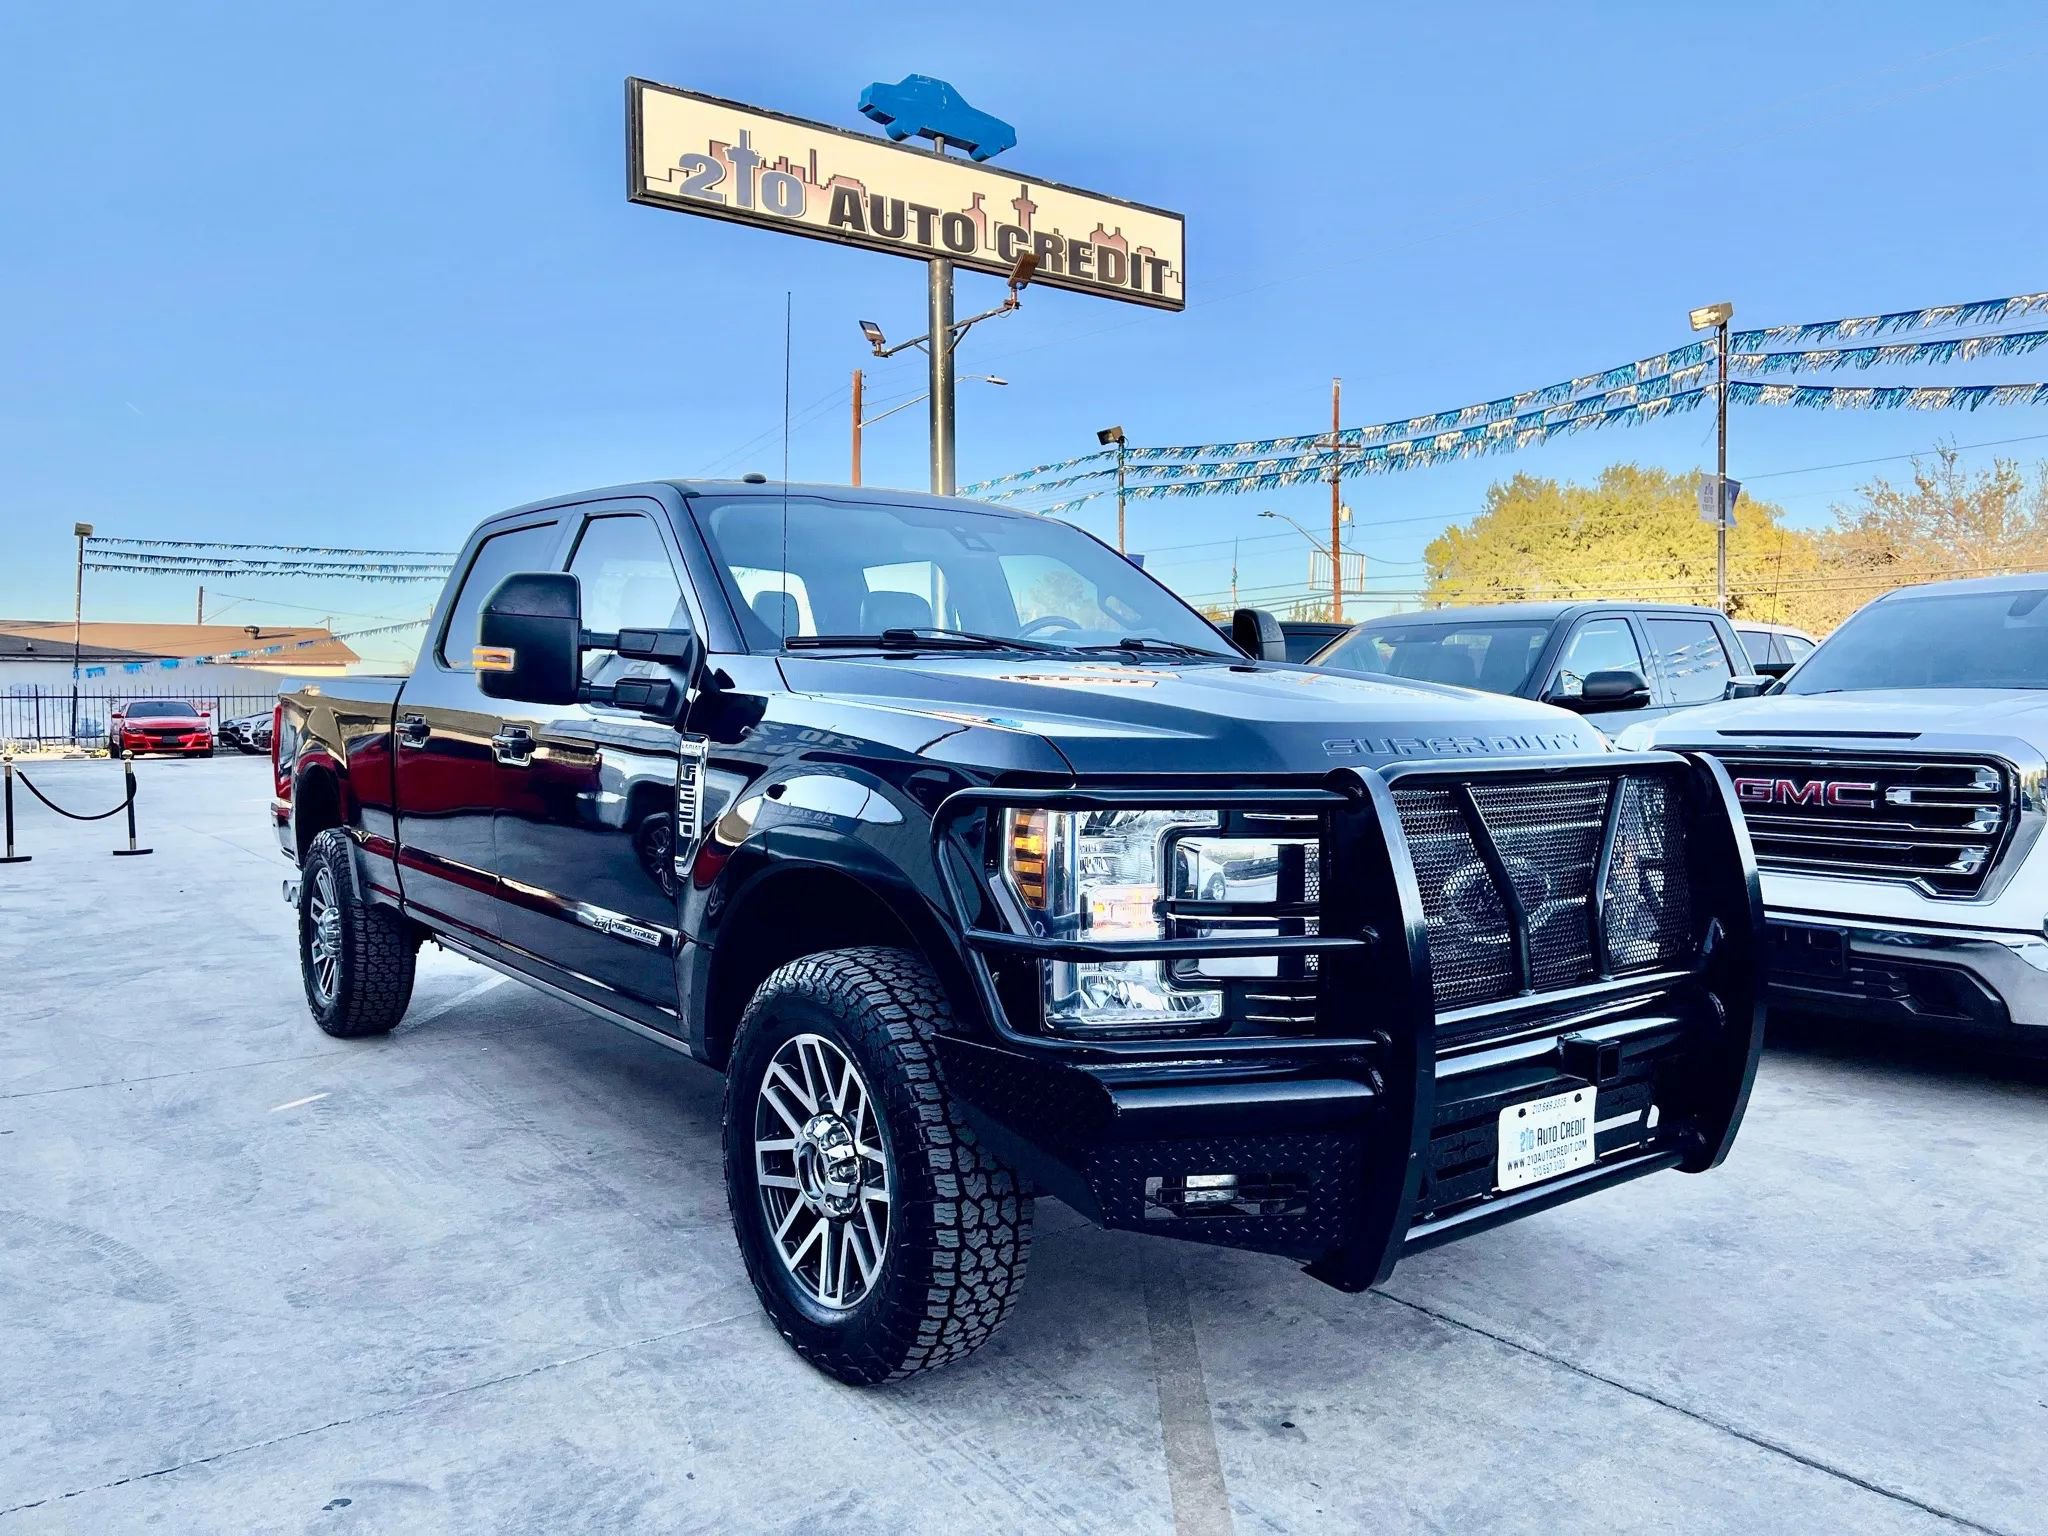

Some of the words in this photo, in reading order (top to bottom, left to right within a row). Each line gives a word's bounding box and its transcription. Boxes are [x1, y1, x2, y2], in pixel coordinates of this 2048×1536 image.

[678, 128, 807, 218] 210
[827, 185, 979, 255] AUTO
[996, 222, 1170, 295] CREDIT
[1320, 737, 1489, 757] SUPER
[1489, 733, 1579, 751] DUTY
[1734, 776, 1877, 808] GMC
[1520, 1127, 1535, 1153] 210
